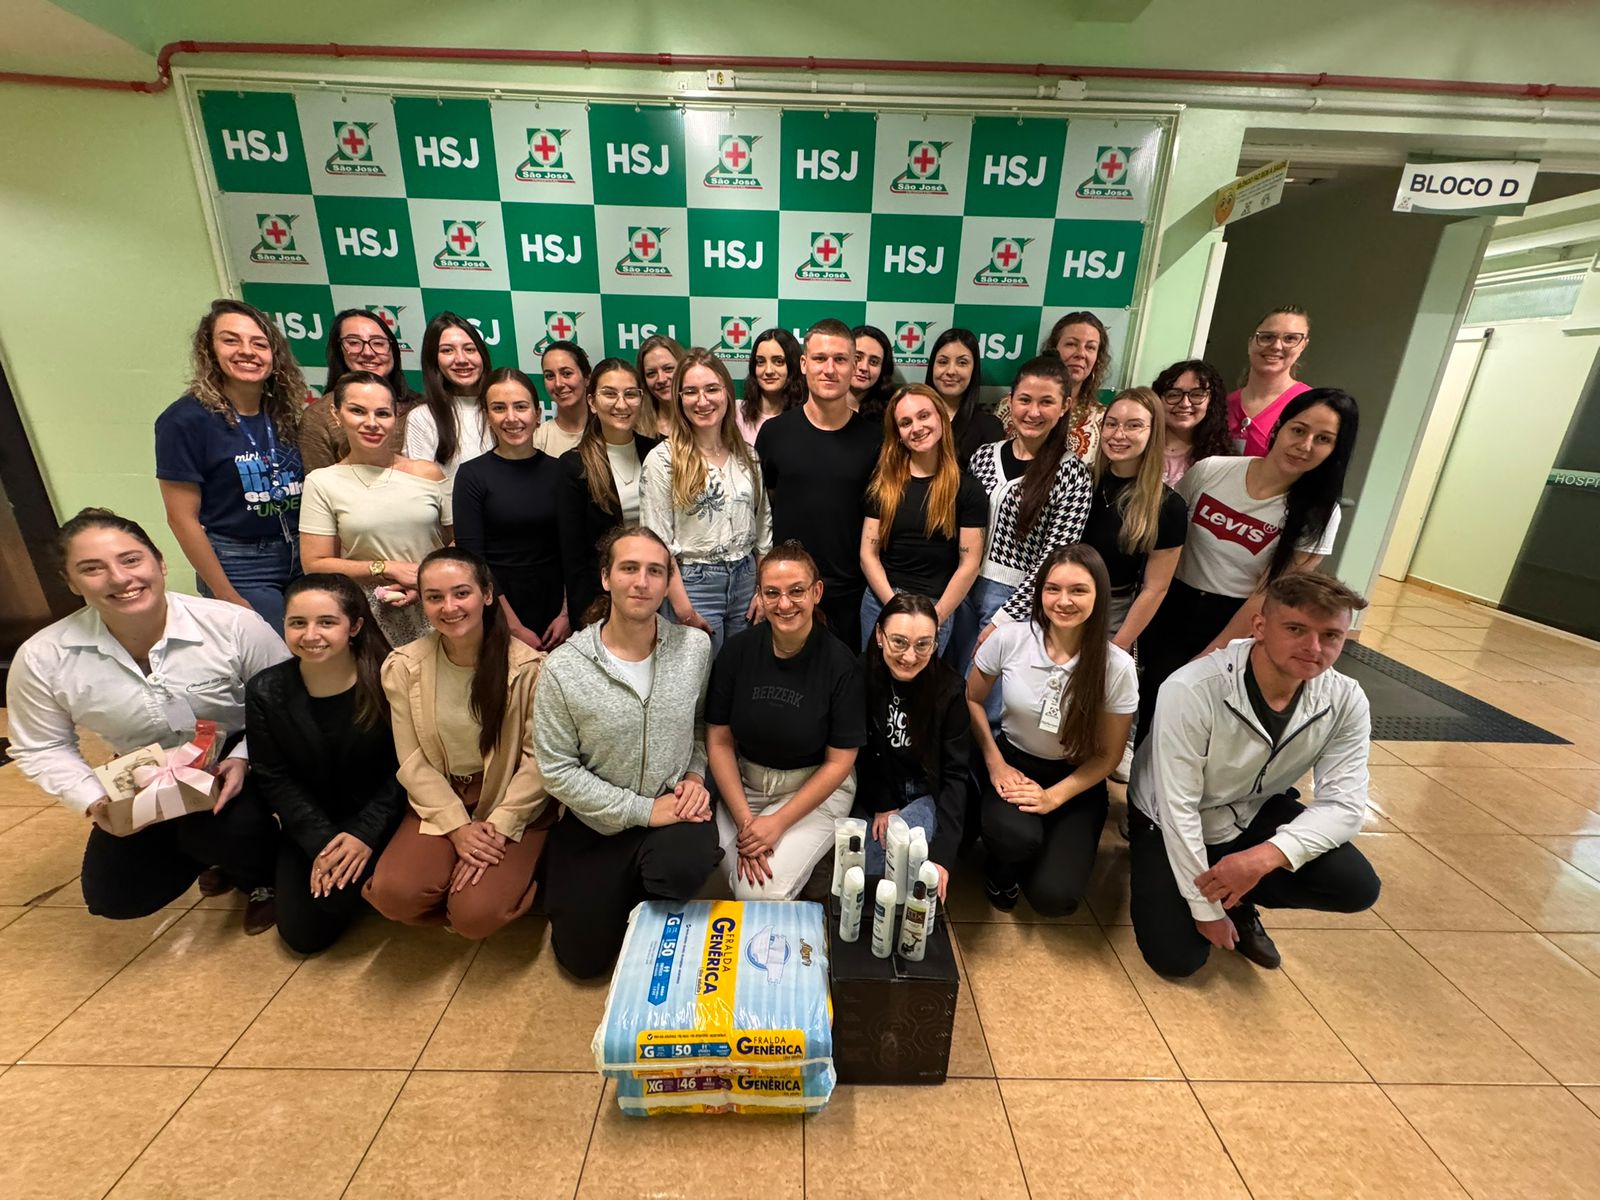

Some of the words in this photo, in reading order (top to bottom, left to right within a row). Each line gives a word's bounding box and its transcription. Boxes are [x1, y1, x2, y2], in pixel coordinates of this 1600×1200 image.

[221, 128, 289, 162] HSJ
[414, 135, 480, 169] HSJ
[332, 164, 351, 172] São
[354, 165, 379, 173] José
[606, 142, 670, 176] HSJ
[796, 149, 859, 181] HSJ
[522, 170, 542, 178] São
[544, 171, 569, 179] José
[710, 177, 730, 185] São
[983, 154, 1048, 187] HSJ
[897, 183, 917, 191] São
[1082, 188, 1102, 196] São
[1409, 173, 1493, 197] BLOCO
[1499, 178, 1520, 197] D
[335, 227, 399, 258] HSJ
[520, 233, 582, 264] HSJ
[440, 259, 459, 267] São
[461, 260, 485, 268] José
[703, 239, 764, 269] HSJ
[883, 244, 945, 275] HSJ
[1062, 249, 1126, 279] HSJ
[622, 265, 641, 273] São
[1001, 276, 1024, 284] José
[466, 318, 501, 346] SJ
[752, 686, 804, 708] BERZERK
[667, 917, 680, 926] G
[661, 942, 676, 957] 50
[703, 917, 736, 995] GENÉRICA
[722, 933, 735, 973] FRALDA
[644, 1046, 655, 1058] G
[675, 1044, 692, 1056] 50
[736, 1036, 803, 1056] GENÉRICA
[753, 1036, 787, 1045] FRALDA
[648, 1080, 664, 1093] XG
[680, 1077, 697, 1089] 46
[737, 1075, 801, 1091] GENÉRICA
